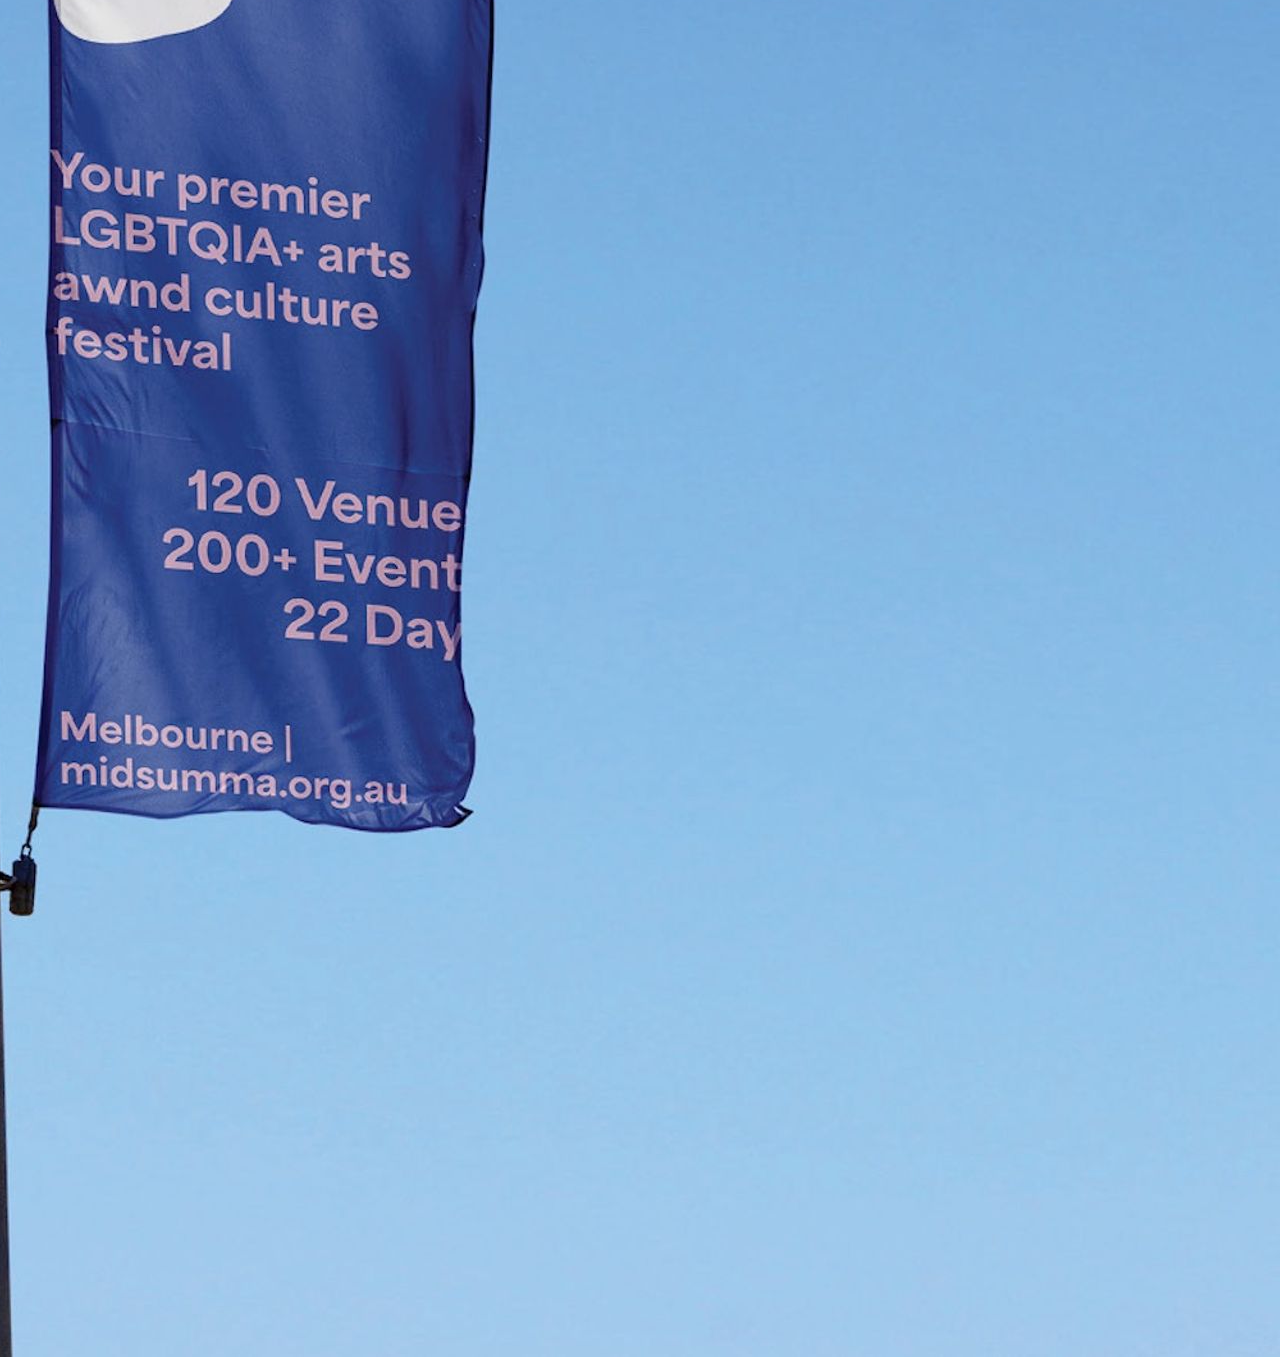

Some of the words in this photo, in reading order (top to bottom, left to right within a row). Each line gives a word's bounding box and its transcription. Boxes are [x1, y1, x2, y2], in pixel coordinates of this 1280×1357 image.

[50, 149, 165, 198] Your
[177, 173, 371, 220] premier
[54, 206, 305, 267] LGBTQIA+
[318, 242, 412, 280] arts
[53, 271, 191, 312] awnd
[204, 282, 379, 331] culture
[54, 317, 232, 371] festival
[187, 469, 281, 517] 120
[295, 477, 462, 532] Venue
[162, 527, 297, 576] 200+
[314, 539, 462, 592] Event
[283, 598, 349, 642] 22
[366, 604, 462, 661] Day
[60, 711, 274, 753] Melbourne
[60, 755, 408, 808] midsumma.org.au
